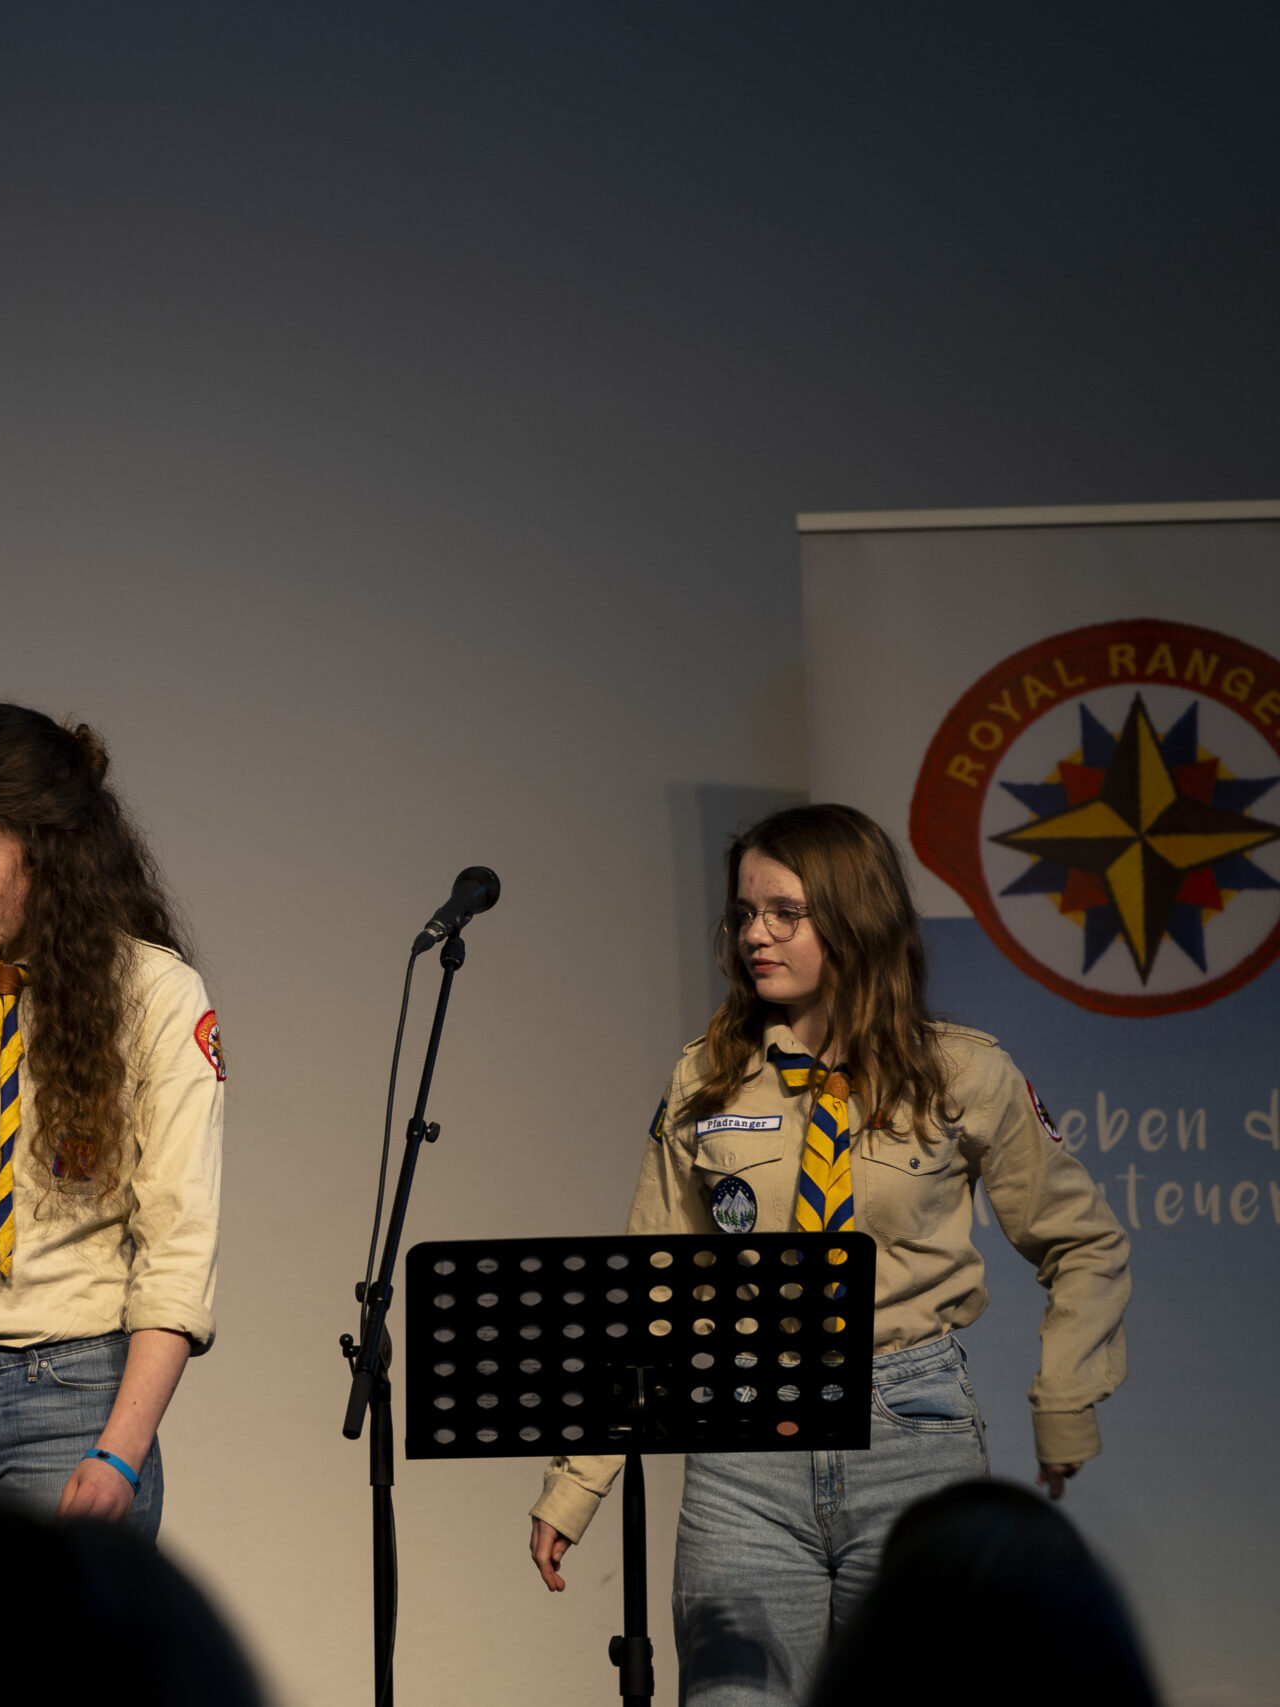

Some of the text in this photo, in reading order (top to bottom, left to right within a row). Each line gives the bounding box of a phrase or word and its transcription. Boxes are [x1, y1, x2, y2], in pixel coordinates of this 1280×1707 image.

[947, 642, 1280, 788] ROYAL RANGE
[707, 1119, 767, 1130] Pfadranger
[1060, 1087, 1280, 1153] eben d
